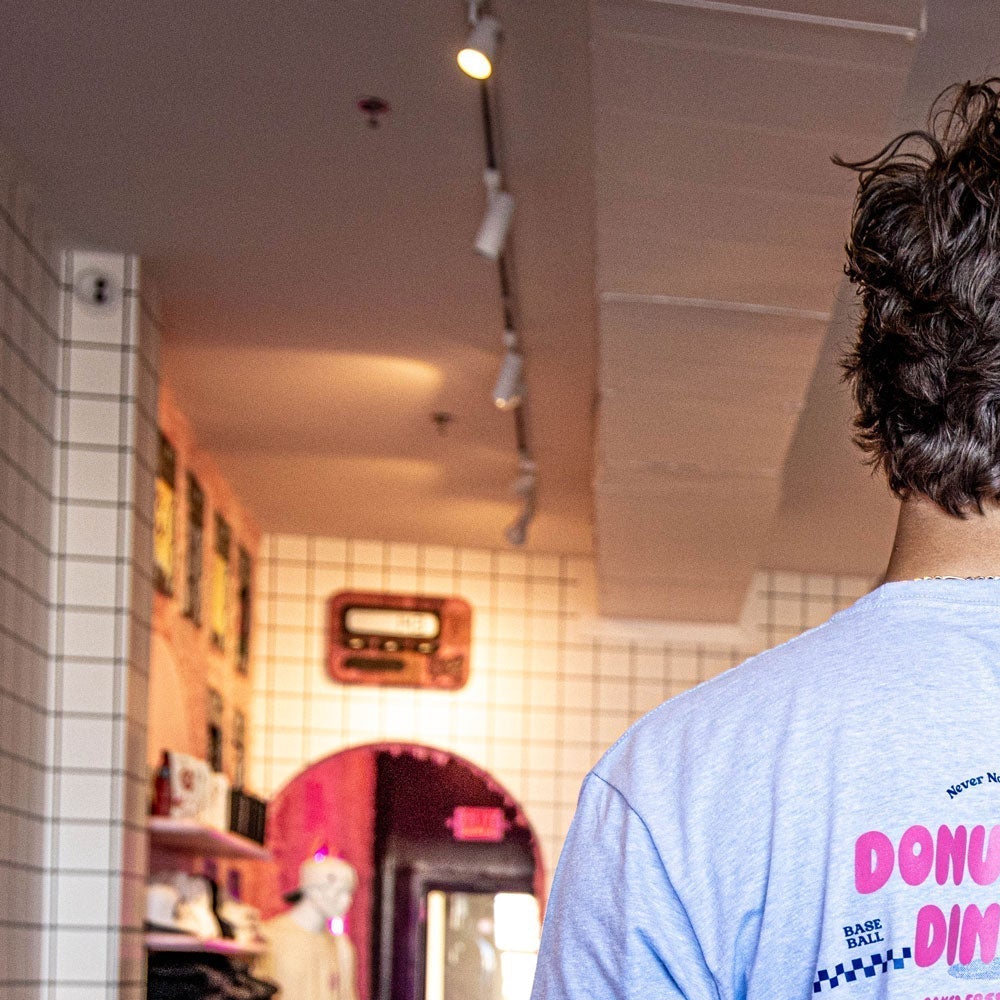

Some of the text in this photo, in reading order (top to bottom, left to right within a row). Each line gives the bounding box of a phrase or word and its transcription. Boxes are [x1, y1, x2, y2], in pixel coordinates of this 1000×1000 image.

[945, 775, 984, 800] Never
[843, 918, 882, 937] BASE
[846, 931, 884, 949] BALL
